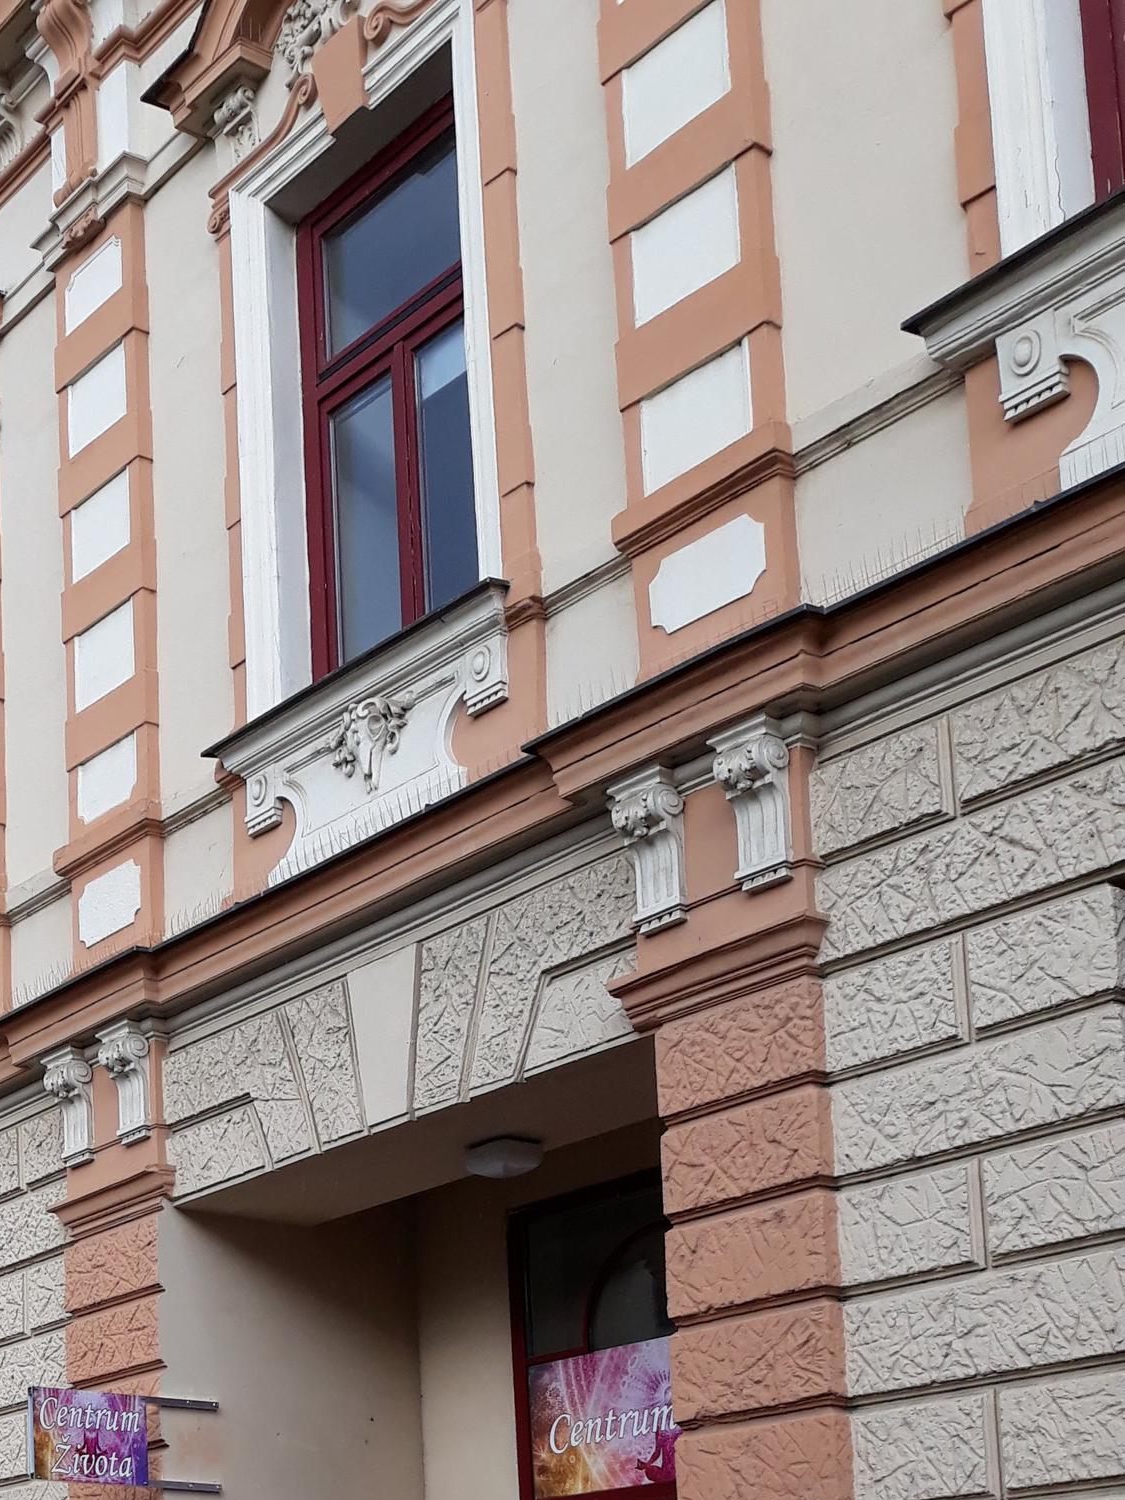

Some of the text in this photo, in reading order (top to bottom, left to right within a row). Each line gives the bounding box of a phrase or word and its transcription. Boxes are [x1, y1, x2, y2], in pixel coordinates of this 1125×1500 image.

[39, 1397, 140, 1432] Centrum
[549, 1404, 676, 1454] Centrum
[51, 1434, 133, 1477] Života
